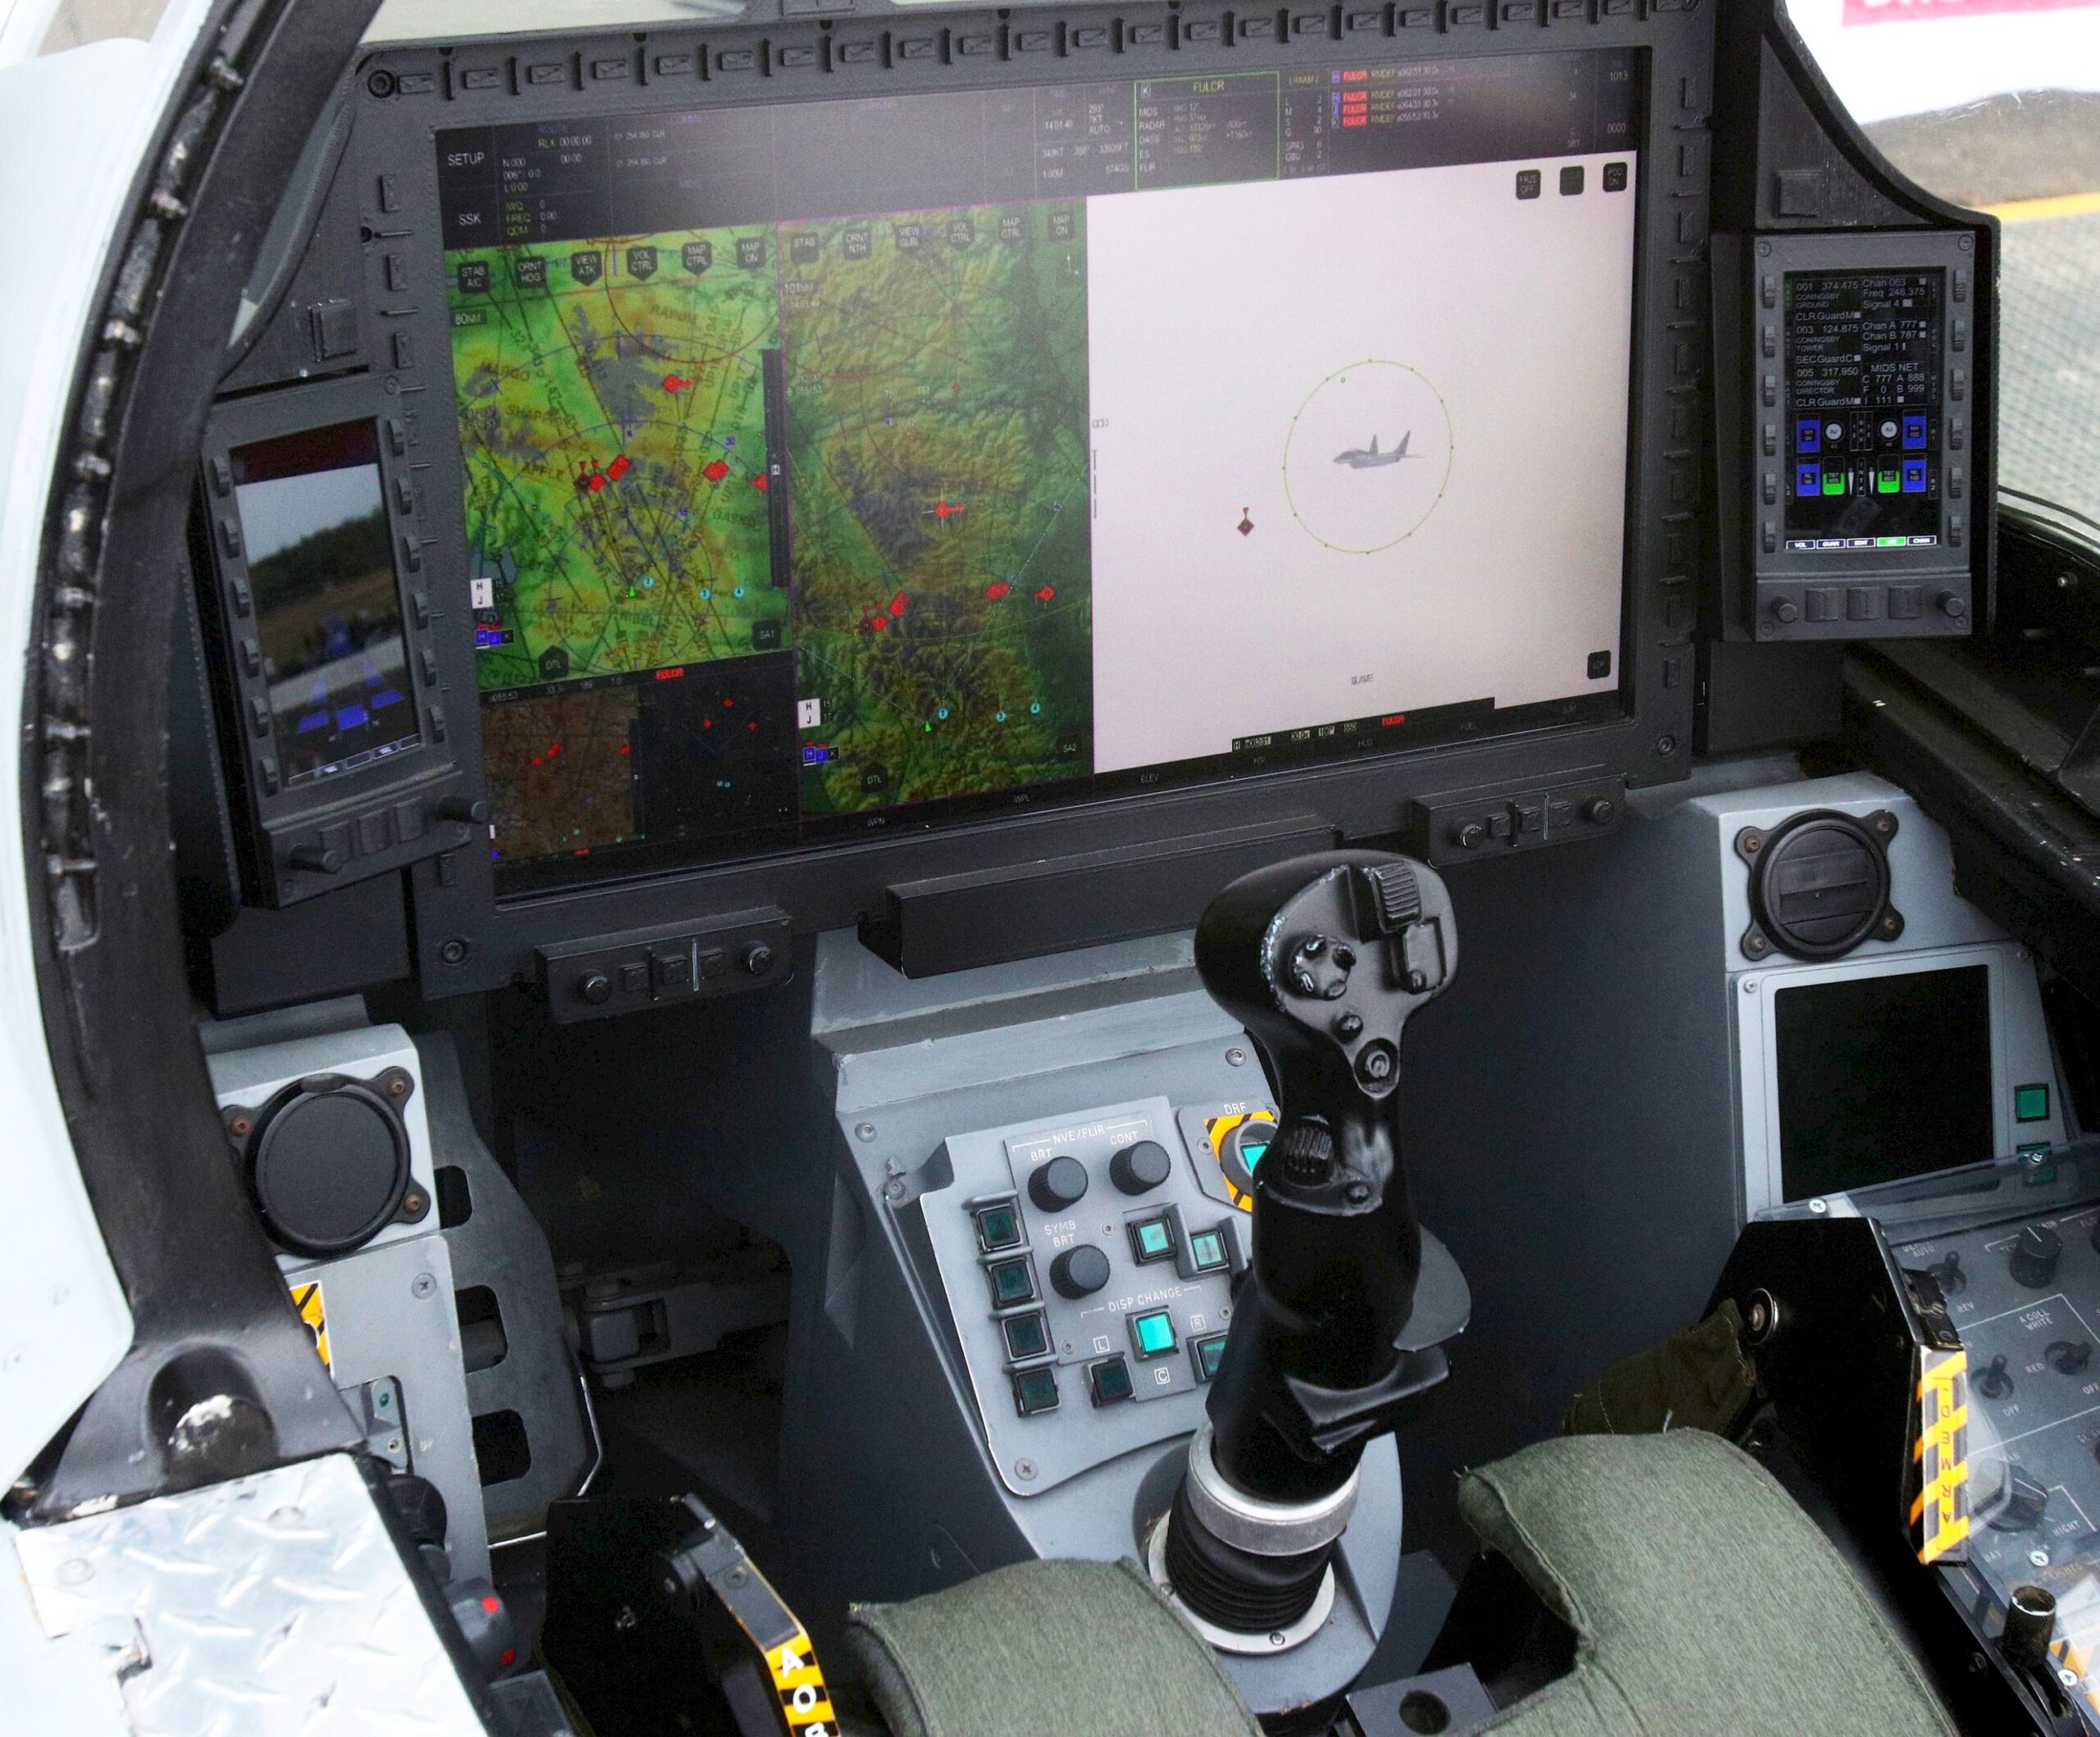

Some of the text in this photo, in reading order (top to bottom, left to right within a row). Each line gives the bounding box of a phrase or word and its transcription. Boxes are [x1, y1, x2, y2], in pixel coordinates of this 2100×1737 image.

[1609, 70, 1629, 82] 1013
[447, 153, 486, 167] SETUP
[459, 213, 482, 226] SSK
[1002, 217, 1020, 228] MAP
[1052, 214, 1071, 226] MAP
[742, 241, 761, 253] MAP
[574, 253, 598, 266] VIEW
[686, 255, 709, 267] CTRL
[745, 253, 759, 263] ON
[578, 266, 596, 276] ATK
[631, 259, 653, 272] CTRL
[461, 266, 486, 278] STAB
[1796, 280, 1860, 292] 001 374.475
[1861, 278, 1887, 289] Chan
[1862, 287, 1926, 299] Freq 248.375
[1796, 301, 1830, 310] GROUND
[1862, 299, 1900, 311] Signal 4
[1796, 312, 1816, 322] CLR
[1816, 311, 1846, 321] Guard
[1796, 323, 1860, 335] 003 124.875
[1862, 320, 1917, 332] Chan A 777
[1862, 331, 1917, 342] Chan B 787
[1796, 344, 1824, 353] TOWER
[1862, 342, 1891, 354] Signal
[1796, 354, 1817, 365] SEC
[1817, 353, 1846, 364] Guard
[1796, 366, 1860, 377] 005 317.950
[1869, 362, 1920, 373] MIDS NET
[1861, 372, 1925, 384] C 777 A 888
[1796, 388, 1836, 396] DIRECTOR
[1862, 383, 1925, 394] F 0 B 999
[1796, 398, 1816, 408] CLR
[1816, 396, 1846, 407] Guard
[476, 581, 484, 591] H
[760, 629, 775, 641] SA1
[805, 702, 813, 712] H
[806, 713, 813, 724] J
[866, 776, 883, 786] DTL
[1223, 1102, 1247, 1115] DRF
[1052, 1124, 1106, 1145] NVE/FLIR
[1110, 1131, 1139, 1146] CONT
[1030, 1148, 1052, 1161] BRT
[1043, 1220, 1077, 1236] SYMB
[1052, 1233, 1075, 1248] BRT
[1107, 1286, 1183, 1312] DISP CHANGE
[1956, 1301, 1975, 1313] REV
[2025, 1317, 2054, 1332] WHITE
[2002, 1403, 2020, 1417] OFF
[2052, 1519, 2081, 1538] NIGHT
